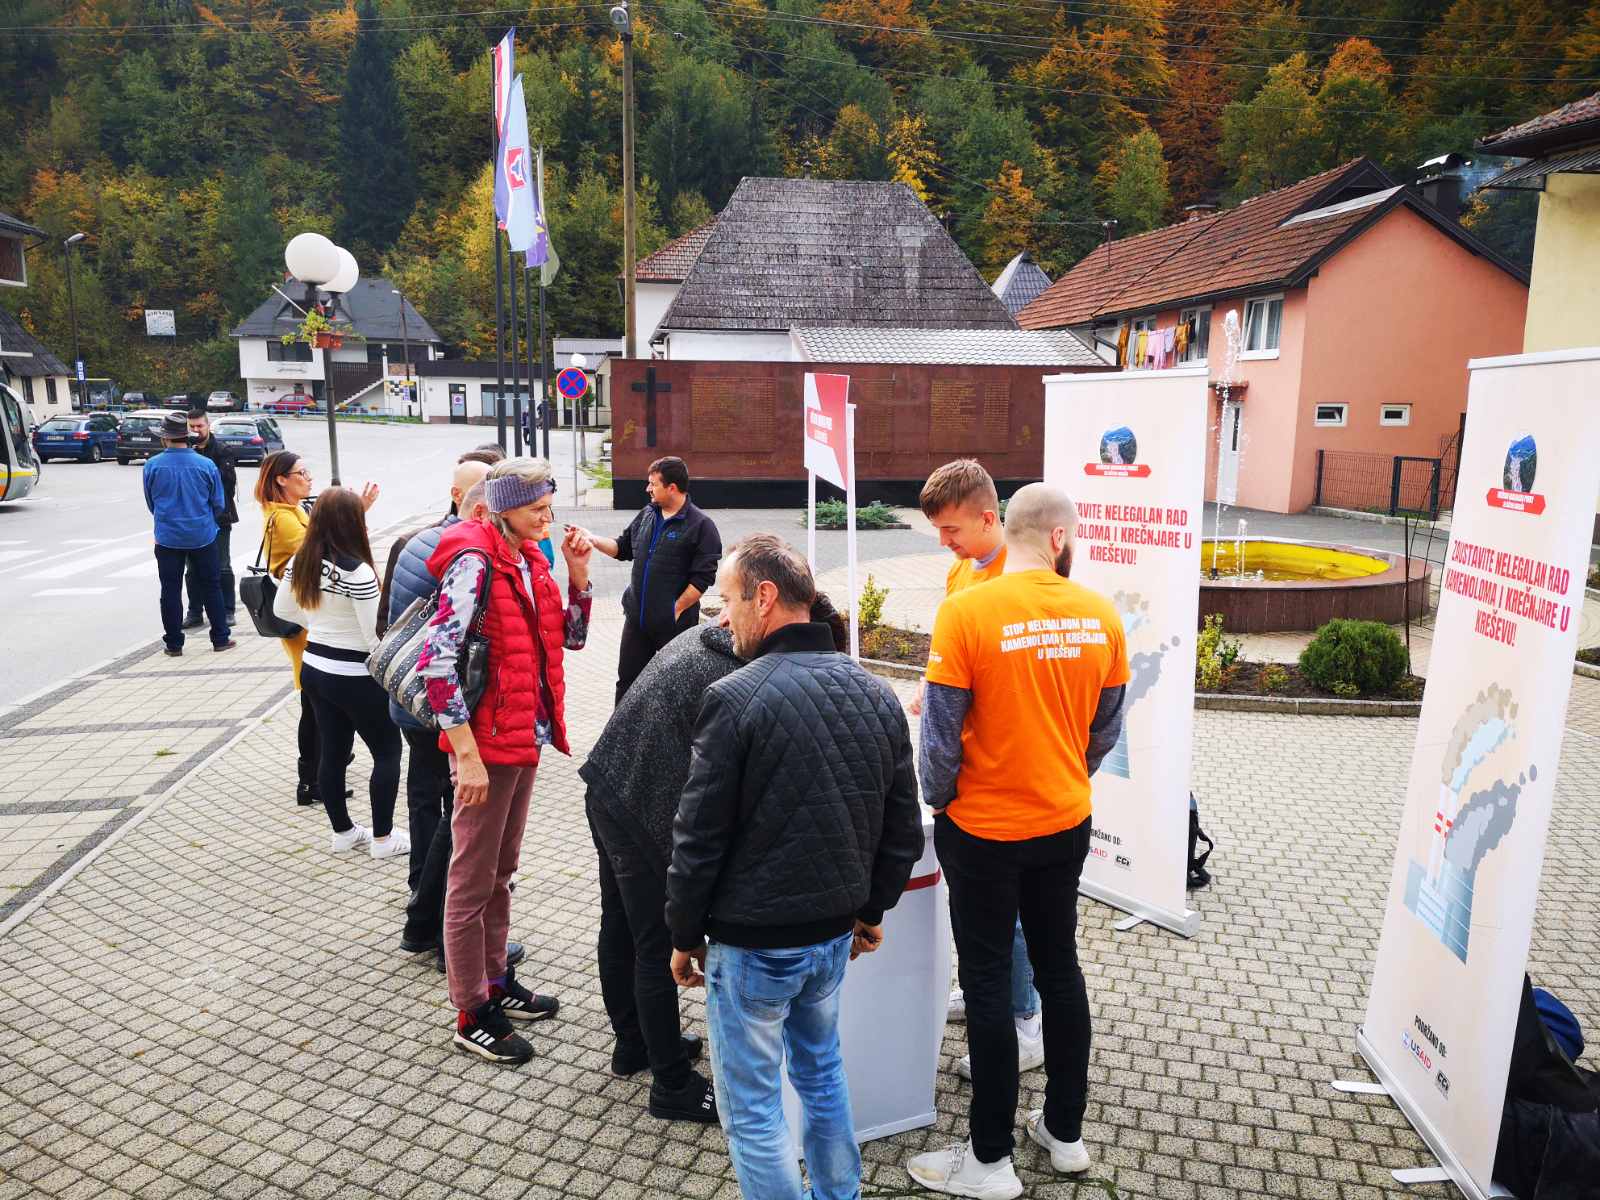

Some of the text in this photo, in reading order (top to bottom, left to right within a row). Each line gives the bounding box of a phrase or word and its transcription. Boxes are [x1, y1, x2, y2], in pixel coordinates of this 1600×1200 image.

[1075, 502, 1188, 526] AVITE NELEGALAN RAD
[1075, 523, 1192, 549] OLOMA I KREČNJARE U
[1090, 543, 1137, 565] KREŠEVU!
[1451, 540, 1570, 595] ZAUSTAVITE NELEGALAN RAD
[1445, 567, 1571, 632] KAMENOLOMA I KREČNJARE U
[1002, 622, 1025, 637] STOP
[1475, 609, 1517, 647] KREŠEVU!
[1410, 1039, 1432, 1069] USAID
